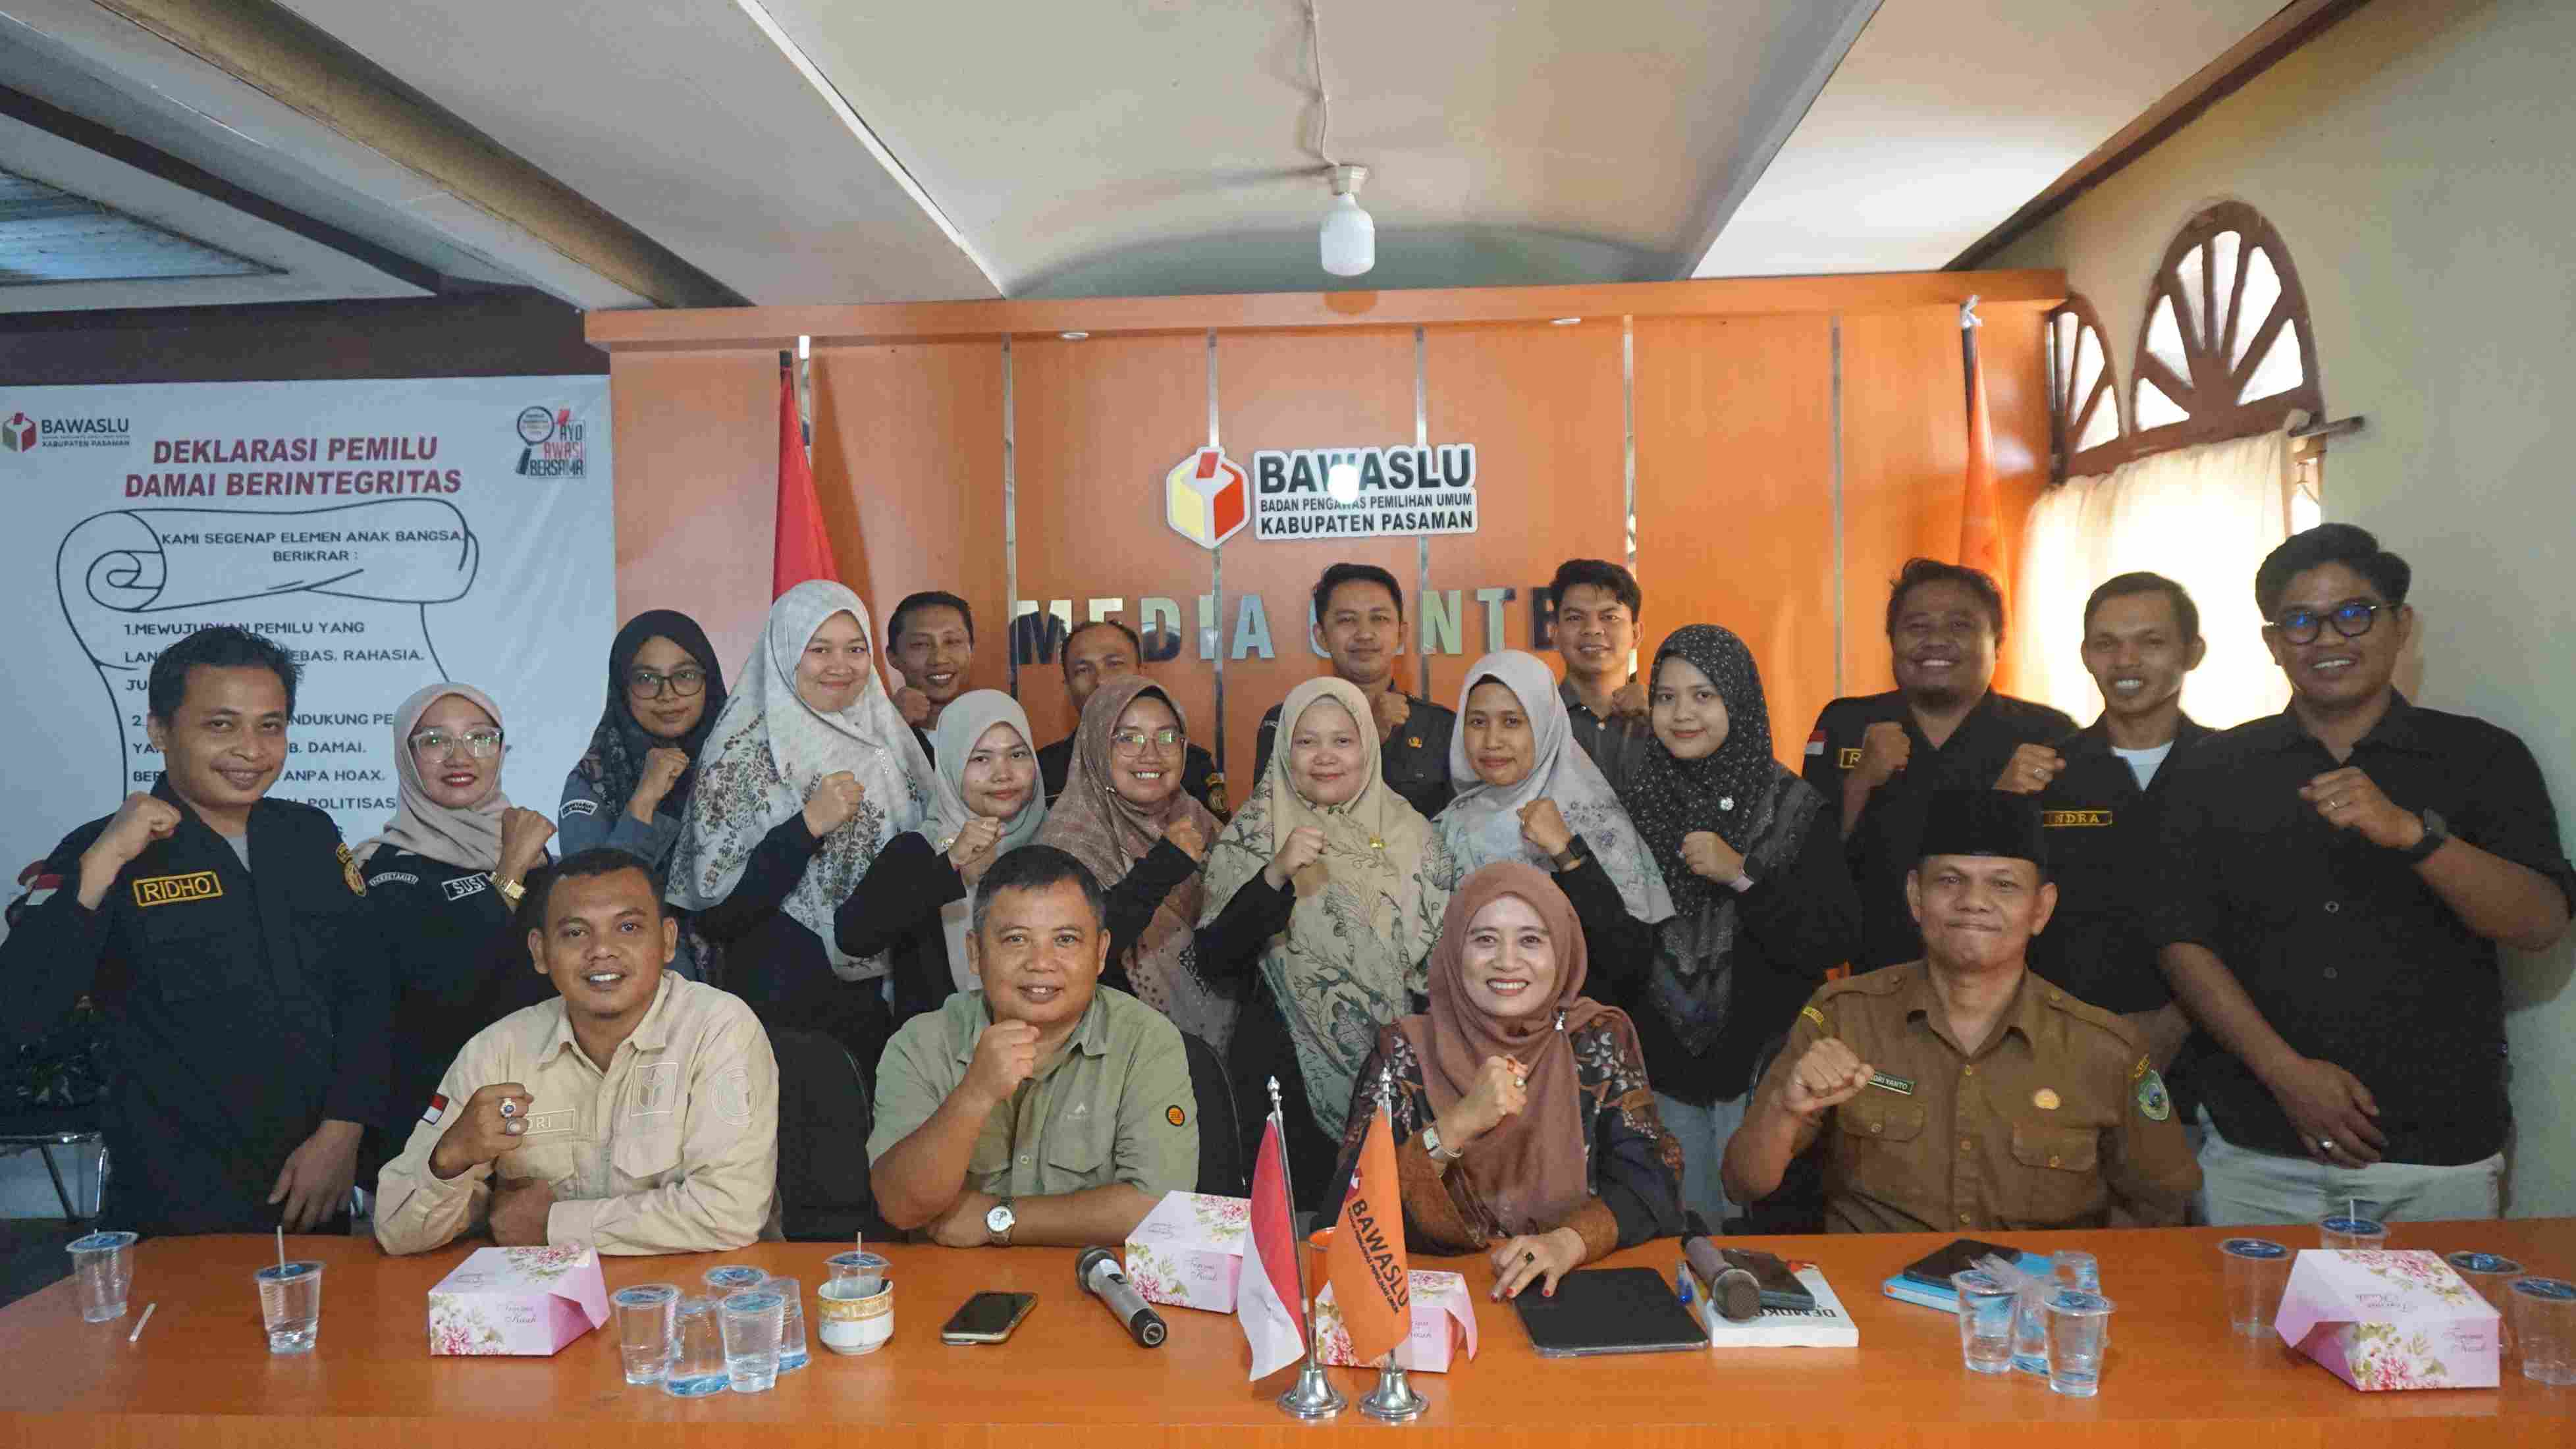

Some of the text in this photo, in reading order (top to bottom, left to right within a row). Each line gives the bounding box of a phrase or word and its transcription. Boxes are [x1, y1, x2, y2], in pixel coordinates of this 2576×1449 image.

[41, 418, 130, 434] BAWASLU
[560, 425, 583, 441] AYO
[153, 436, 438, 463] DEKLARASI PEMILU
[125, 469, 462, 498] DAMAI BERINTEGRITAS
[1260, 498, 1299, 512] BADAN
[1370, 494, 1433, 509] PEMILIHAN
[1437, 492, 1472, 506] UMUM
[1261, 511, 1472, 535] KABUPATEN PASAMAN
[162, 533, 200, 544] KAMI
[205, 532, 276, 544] SEGENAP
[281, 531, 341, 543] ELEMEN
[346, 531, 390, 542] ANAK
[273, 550, 349, 562] BERIKRAR
[255, 622, 313, 634] PEMILU
[319, 621, 364, 633] YANG
[308, 797, 396, 810] POLITISAS
[143, 876, 211, 901] RIDHO
[452, 876, 486, 895] SUSI
[1353, 1198, 1409, 1306] BAWASLU
